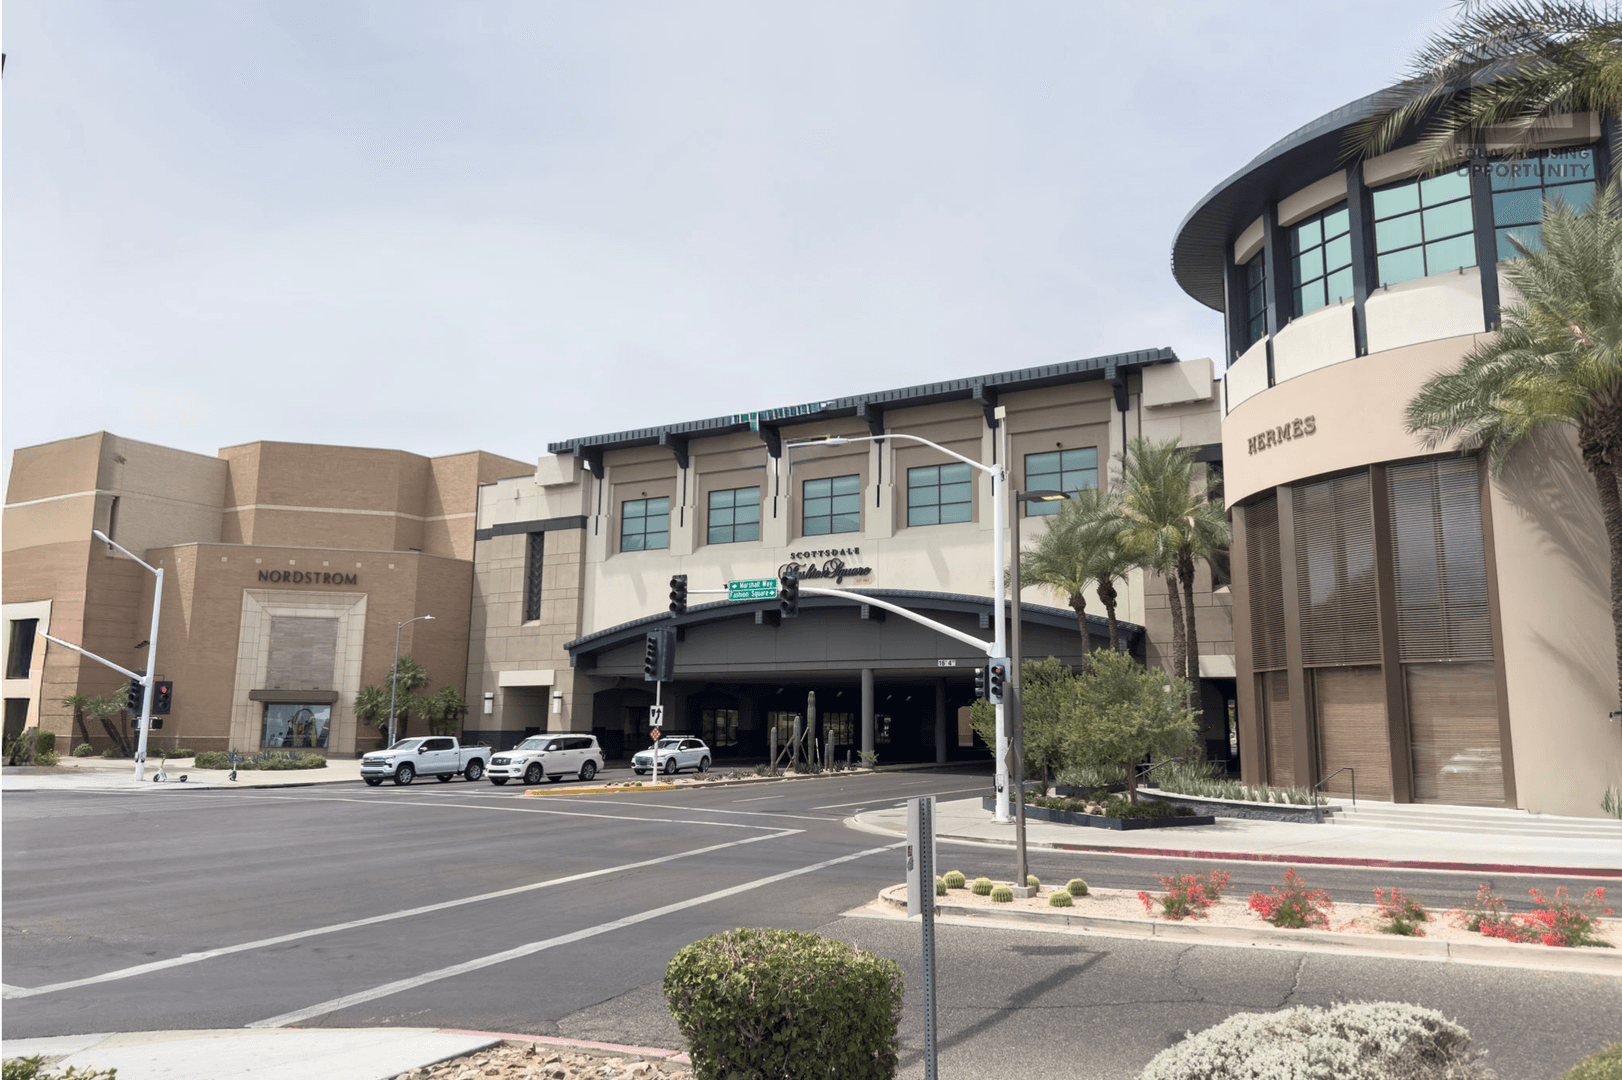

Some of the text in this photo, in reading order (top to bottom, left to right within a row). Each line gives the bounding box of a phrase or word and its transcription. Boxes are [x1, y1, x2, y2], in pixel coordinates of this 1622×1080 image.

[790, 547, 860, 559] SCOTTSDALE
[258, 569, 357, 585] NORDSTROM
[729, 590, 769, 599] Fashion Square
